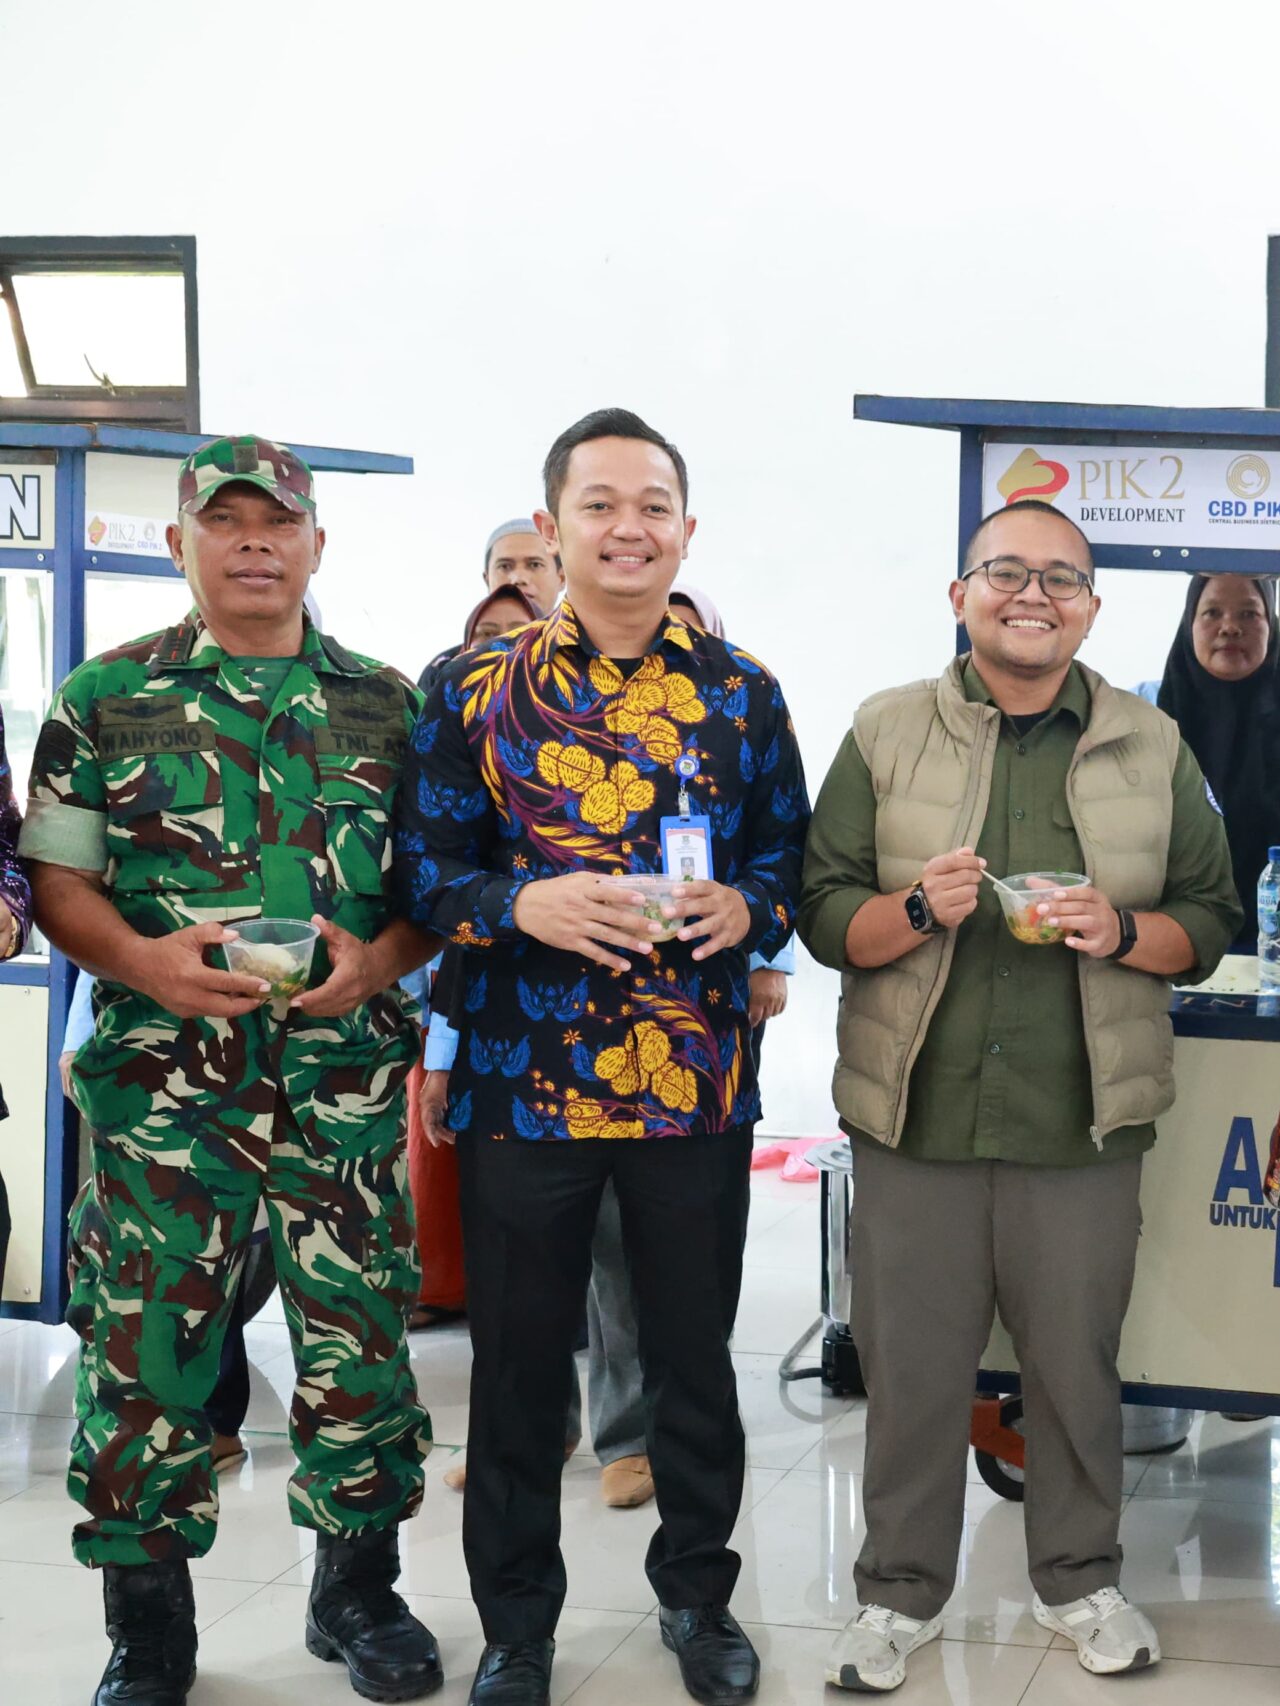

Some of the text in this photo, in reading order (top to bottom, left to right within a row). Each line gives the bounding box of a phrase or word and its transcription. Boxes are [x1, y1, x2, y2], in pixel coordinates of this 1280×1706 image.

[1080, 507, 1185, 522] DEVELOPMENT
[1208, 500, 1247, 517] CBD
[101, 726, 202, 754] WAHYONO
[1210, 1203, 1277, 1230] UNTUK
